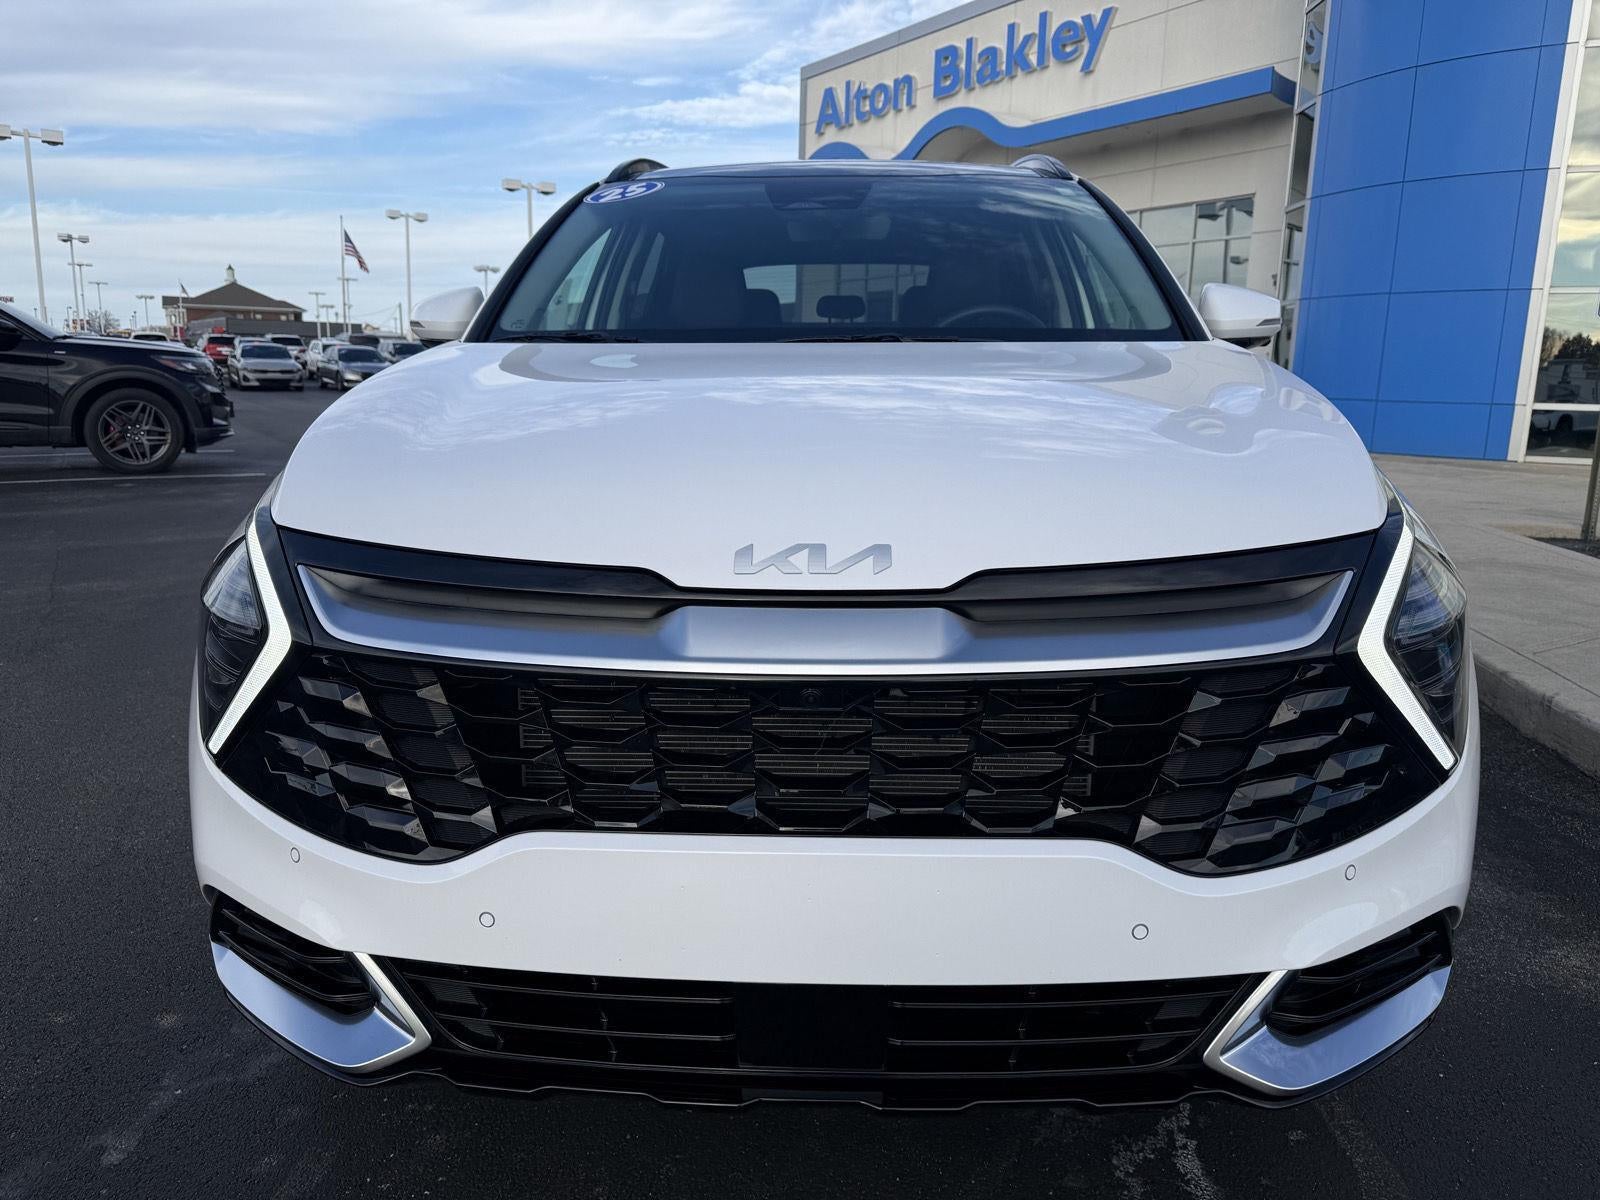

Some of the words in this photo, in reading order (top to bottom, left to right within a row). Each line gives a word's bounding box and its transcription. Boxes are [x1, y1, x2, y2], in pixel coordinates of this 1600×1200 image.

[814, 73, 915, 135] Alton
[932, 6, 1116, 99] Blakley
[598, 182, 648, 203] 25
[733, 542, 893, 575] KIA
